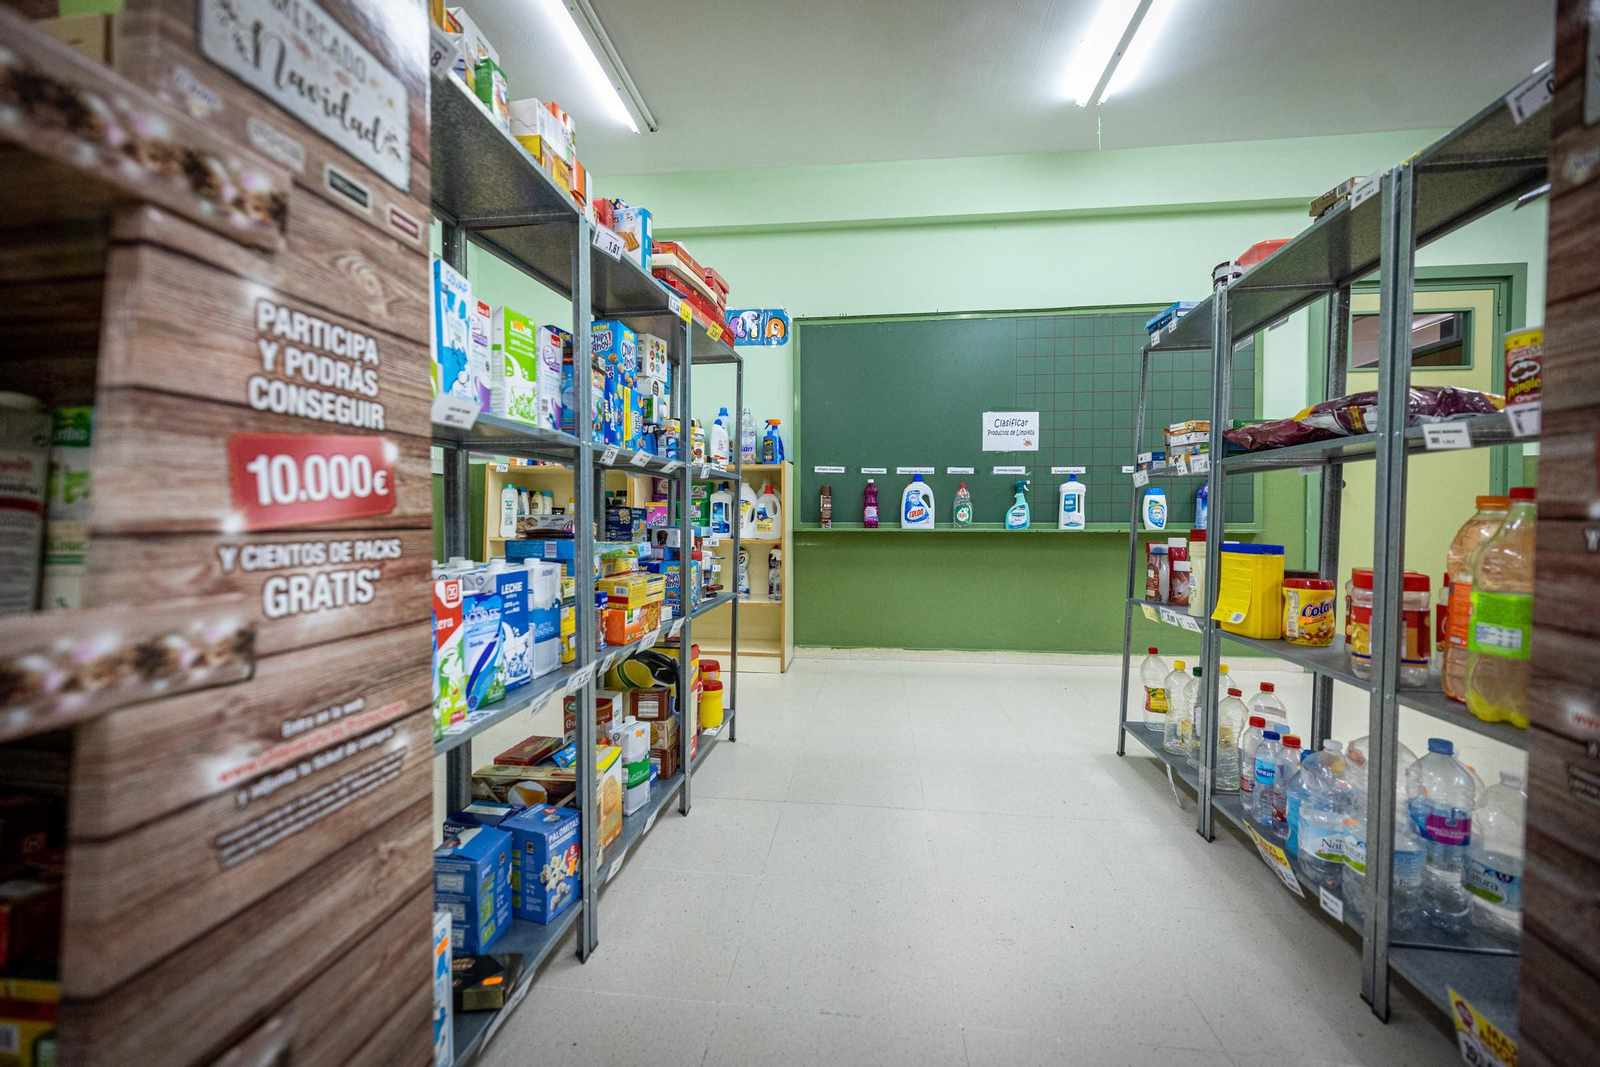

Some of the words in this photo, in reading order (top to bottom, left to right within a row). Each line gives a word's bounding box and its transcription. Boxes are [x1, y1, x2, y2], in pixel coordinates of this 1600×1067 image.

[252, 19, 386, 154] Navidad
[257, 299, 380, 366] PARTICIPA
[258, 338, 278, 371] Y
[284, 347, 379, 398] PODRÁS
[246, 375, 385, 431] CONSEGUIR
[994, 418, 1029, 428] Clasificar
[218, 546, 237, 573] Y
[240, 543, 326, 572] CIENTOS
[327, 541, 352, 565] DE
[353, 538, 402, 561] PACKS
[501, 581, 523, 595] LECHE
[548, 817, 580, 844] PALOMITAS
